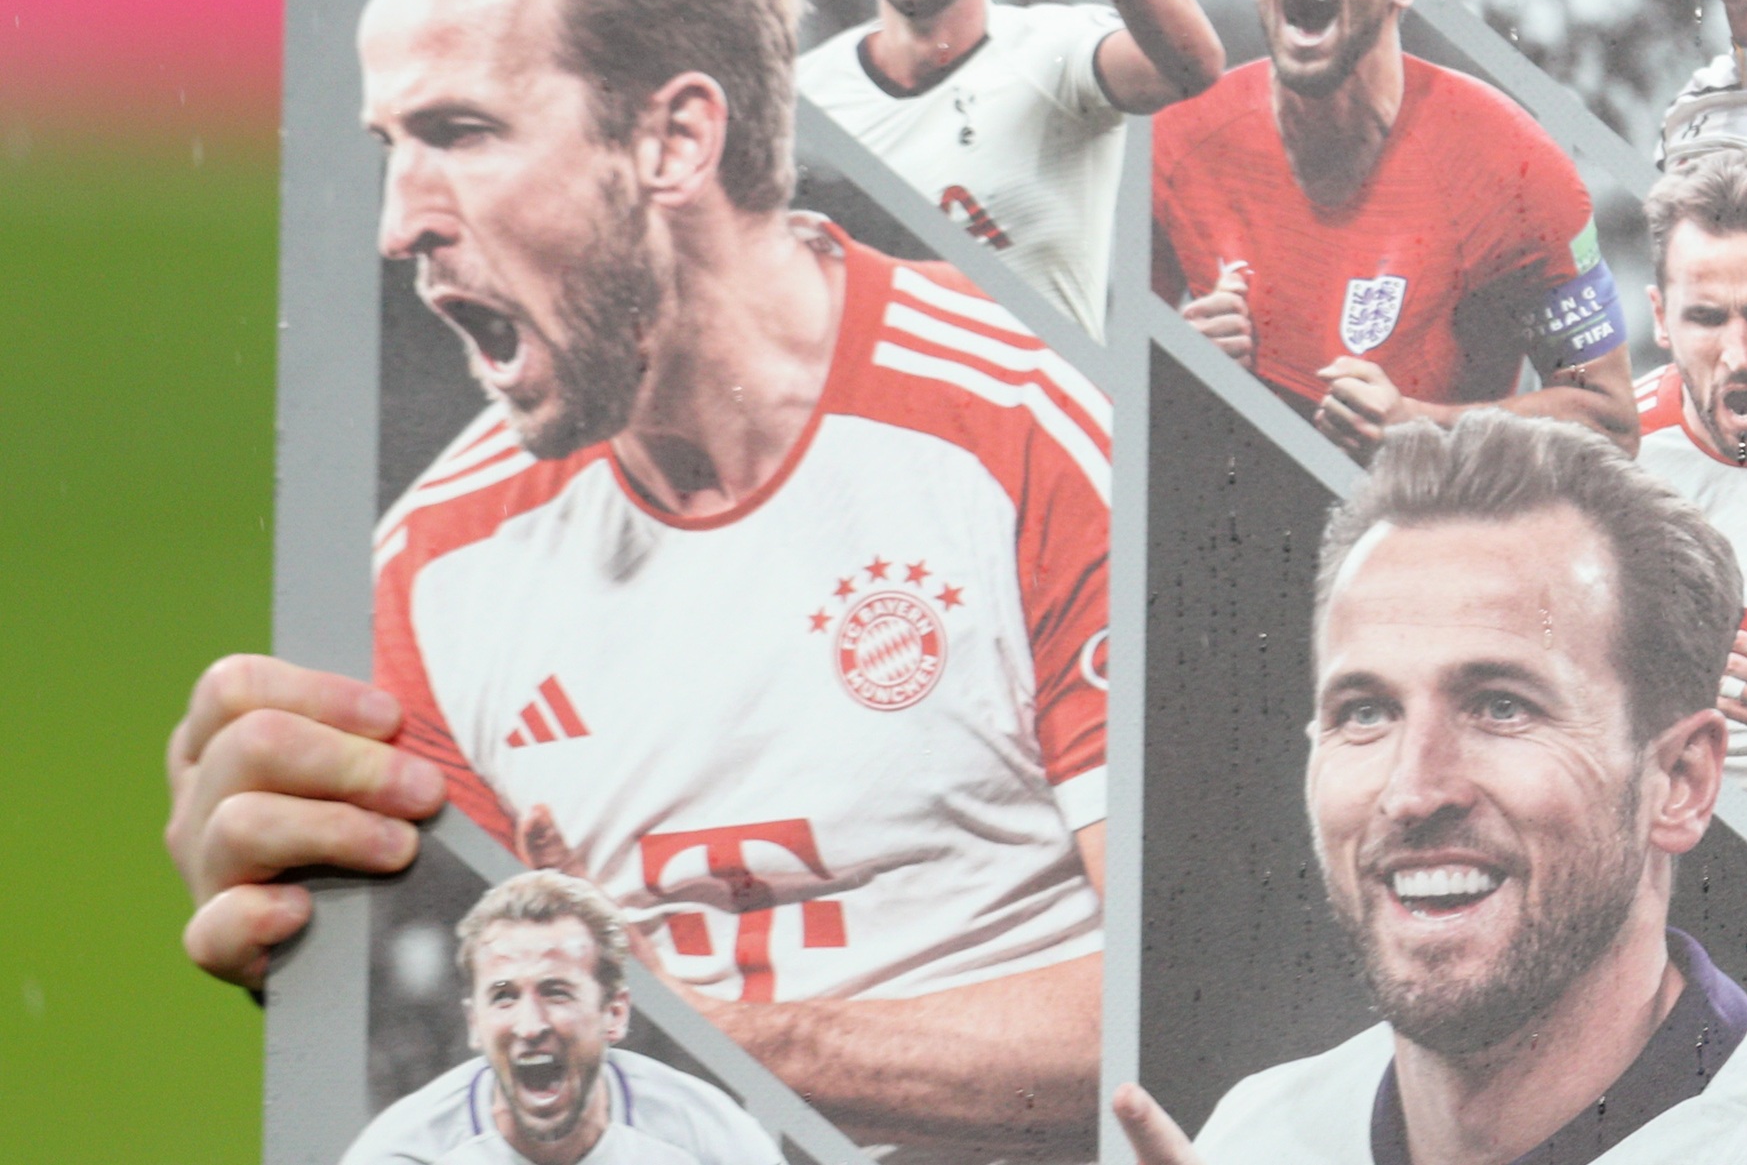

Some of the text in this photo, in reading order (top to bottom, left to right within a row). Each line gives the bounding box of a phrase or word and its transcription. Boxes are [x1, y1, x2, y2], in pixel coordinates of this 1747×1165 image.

[1571, 321, 1615, 350] FIFA
[841, 599, 934, 650] FC BAYERN
